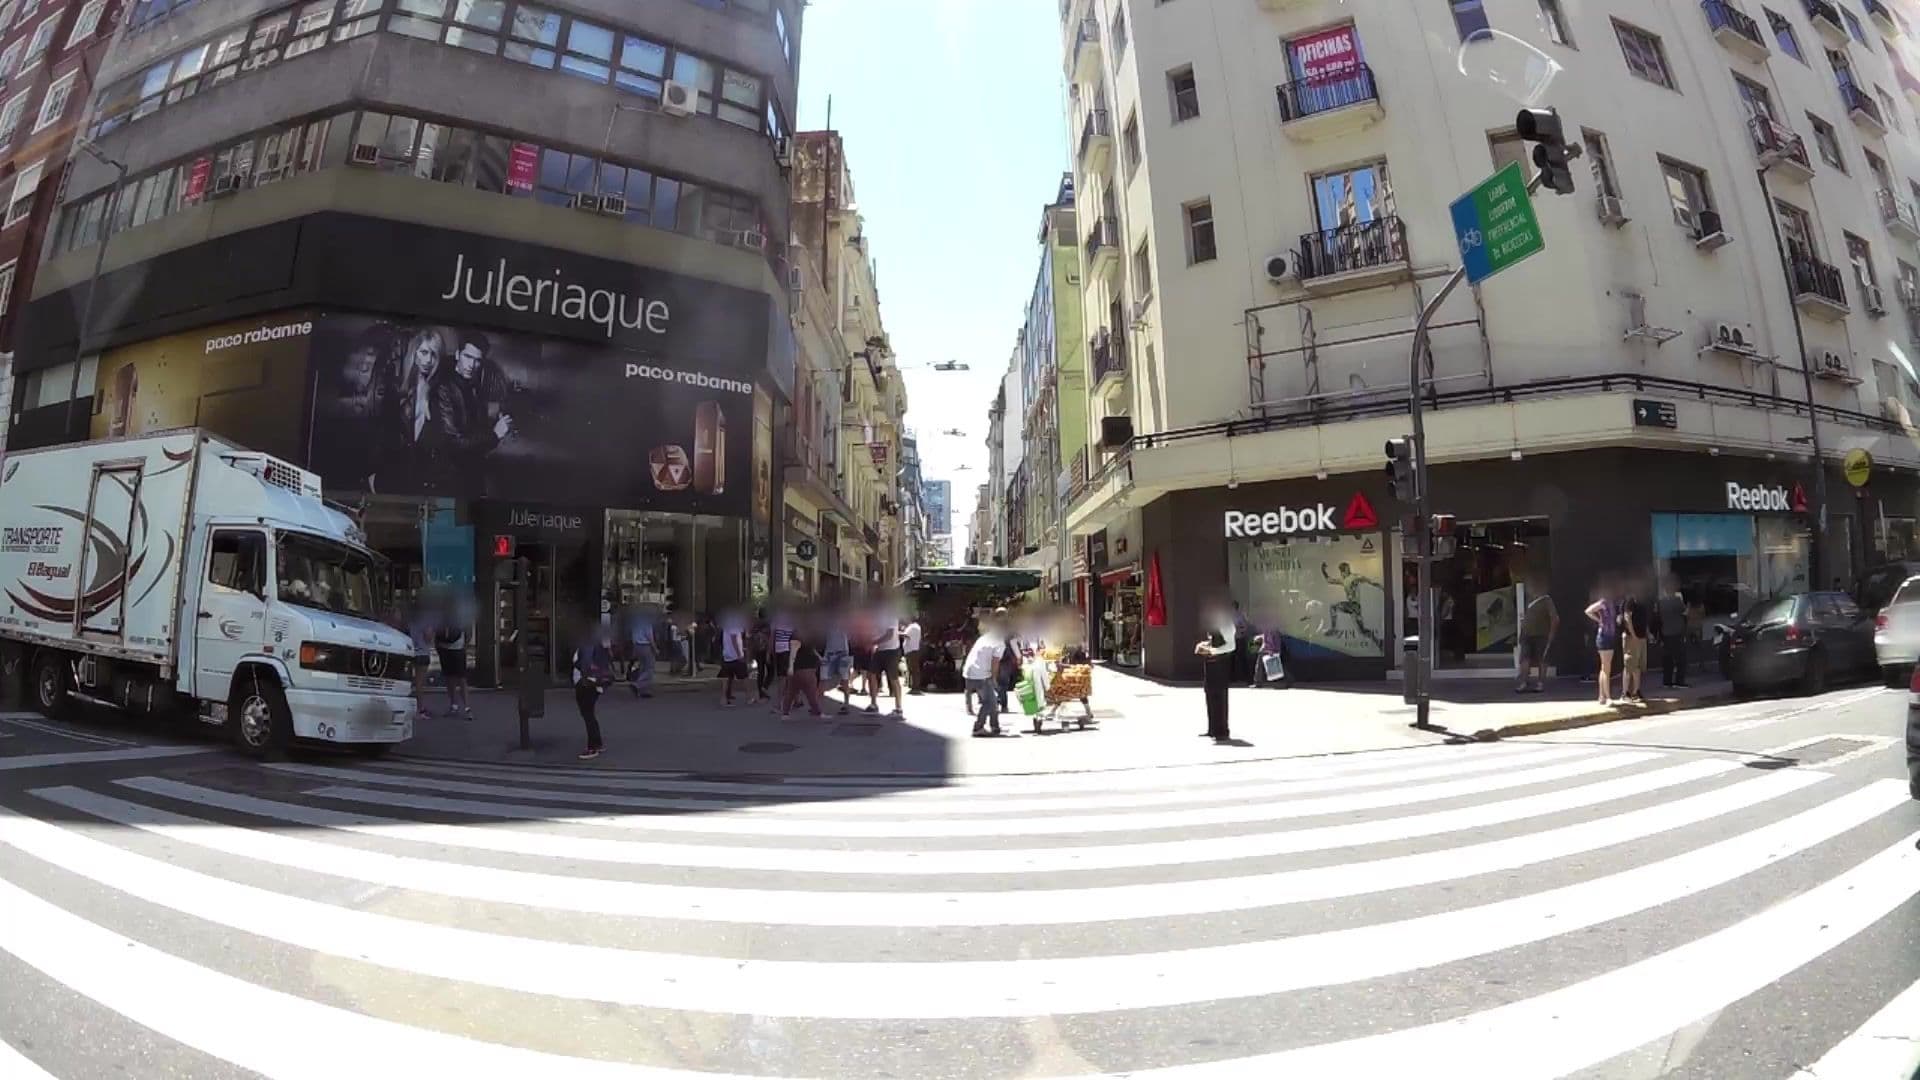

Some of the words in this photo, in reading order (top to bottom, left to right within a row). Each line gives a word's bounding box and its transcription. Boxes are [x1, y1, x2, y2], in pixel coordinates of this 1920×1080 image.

[1297, 33, 1352, 63] OFICINAS
[442, 254, 669, 337] Juleriaque
[205, 333, 242, 354] paco
[244, 321, 312, 344] rabanne
[625, 363, 674, 381] paco
[676, 371, 752, 394] rabanne
[1726, 481, 1790, 511] Reebok
[508, 508, 582, 533] Juleriaque
[1224, 503, 1337, 537] Reebok
[2, 527, 63, 545] TRANSPORTE
